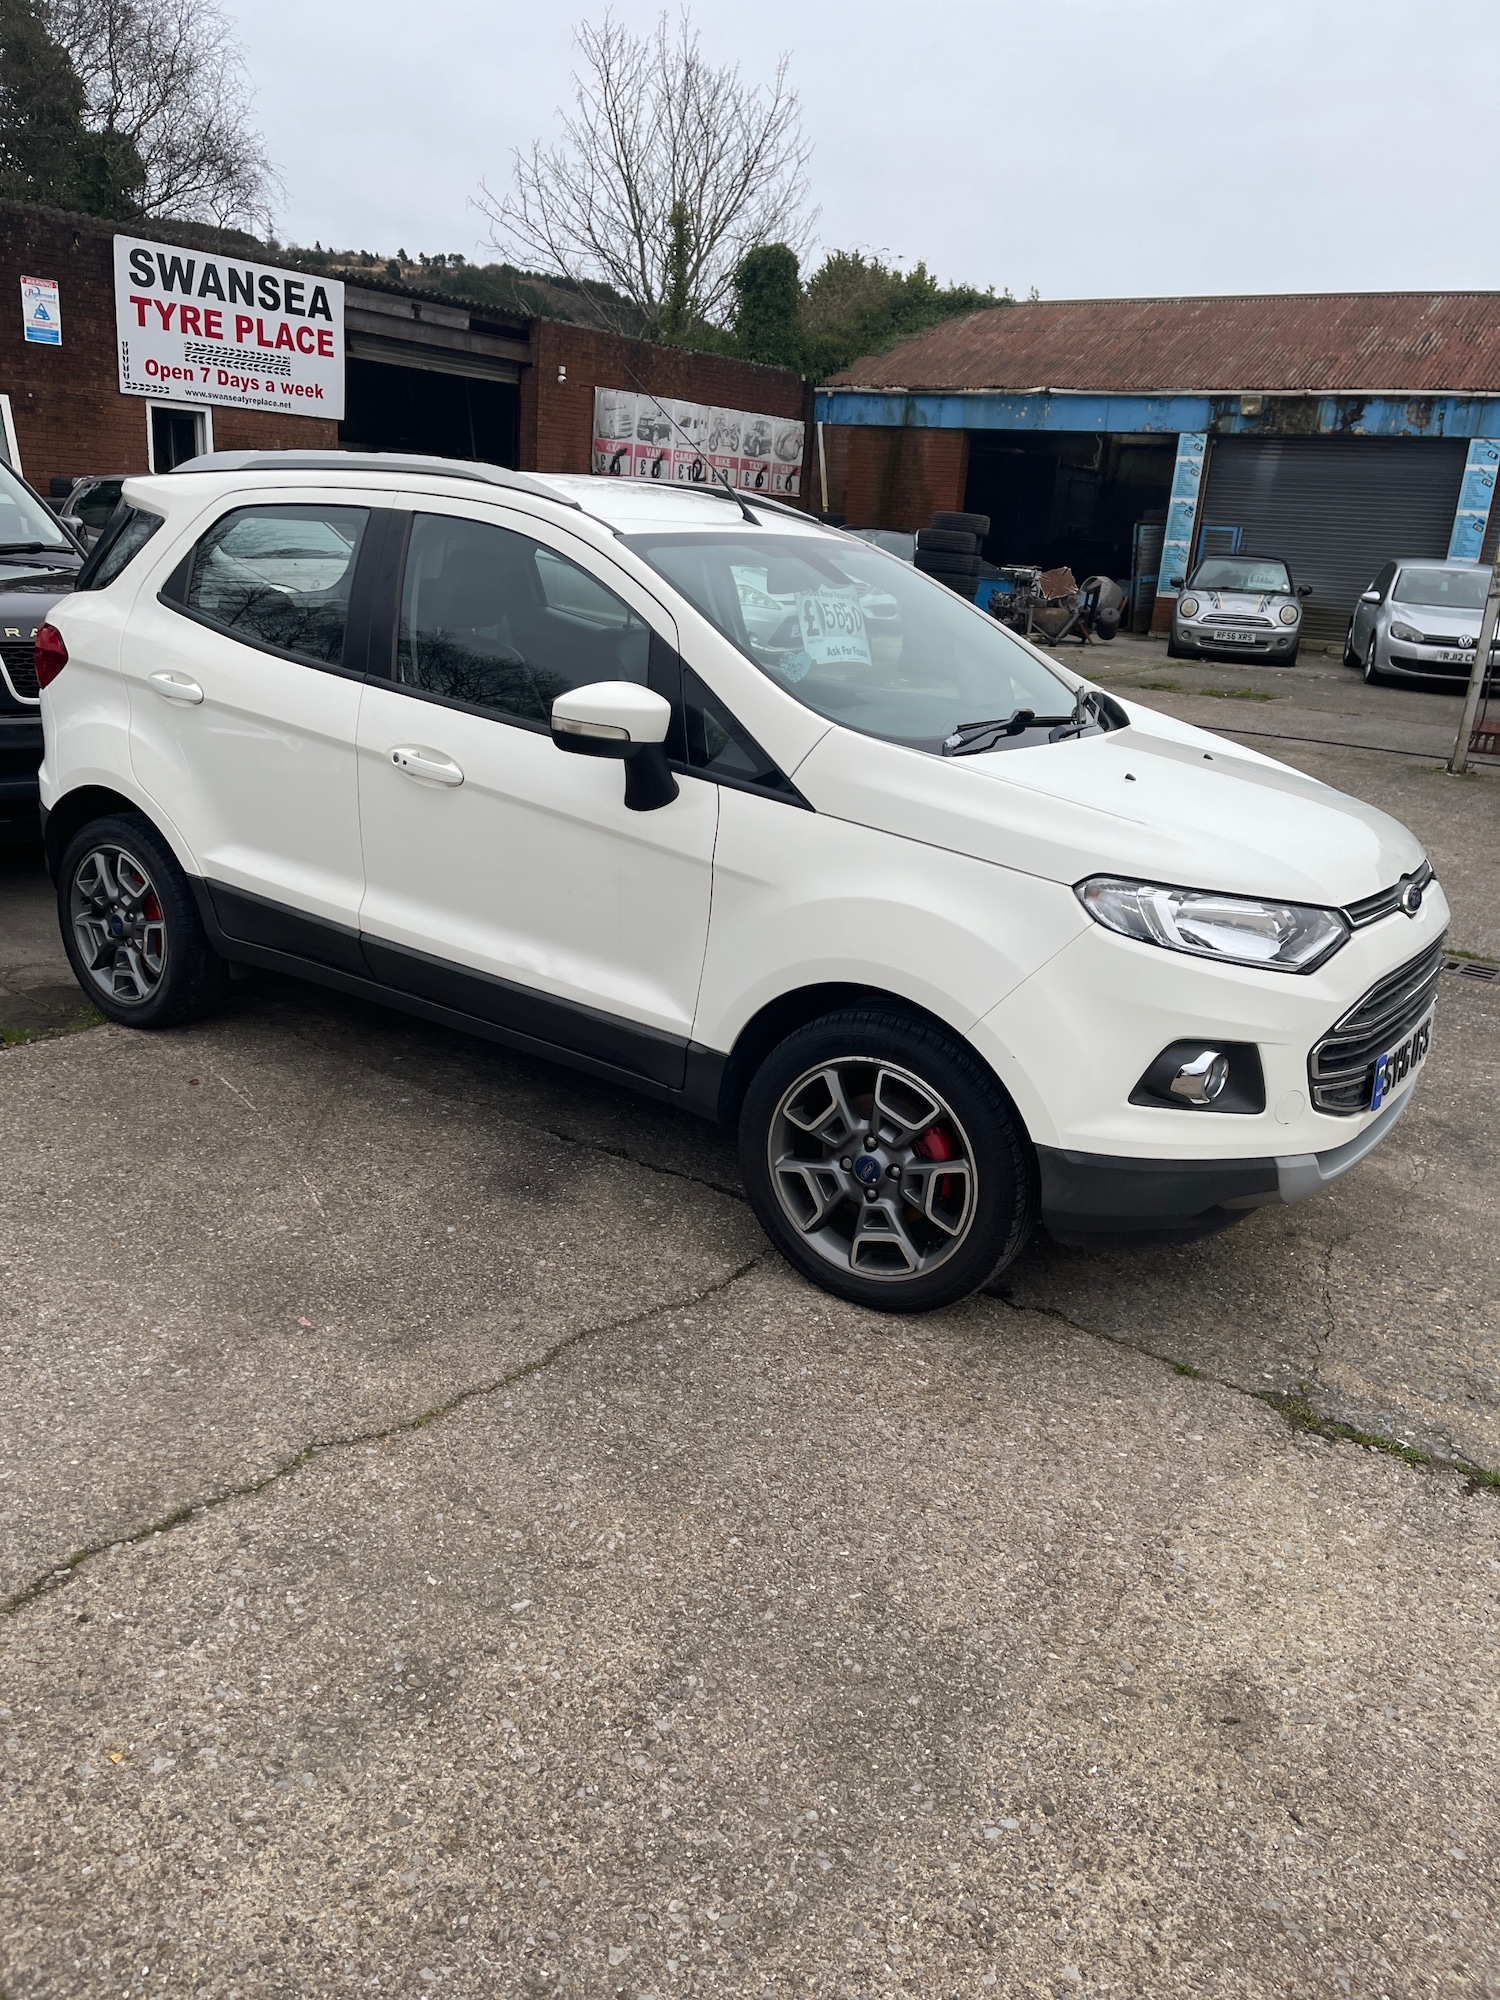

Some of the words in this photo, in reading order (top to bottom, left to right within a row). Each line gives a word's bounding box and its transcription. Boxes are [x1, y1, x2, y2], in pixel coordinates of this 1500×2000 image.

[129, 248, 333, 322] SWANSEA
[129, 295, 224, 340] TYRE
[235, 314, 334, 358] PLACE
[145, 359, 194, 382] Open
[200, 367, 211, 383] 7
[217, 369, 260, 393] Days
[265, 380, 275, 393] a
[280, 383, 324, 400] week
[184, 389, 292, 409] www.swanseatyreplace.net
[645, 447, 662, 458] VAN
[715, 456, 731, 467] BIKE
[827, 646, 841, 657] Ask
[841, 645, 851, 656] For
[1443, 652, 1463, 661] RJ12
